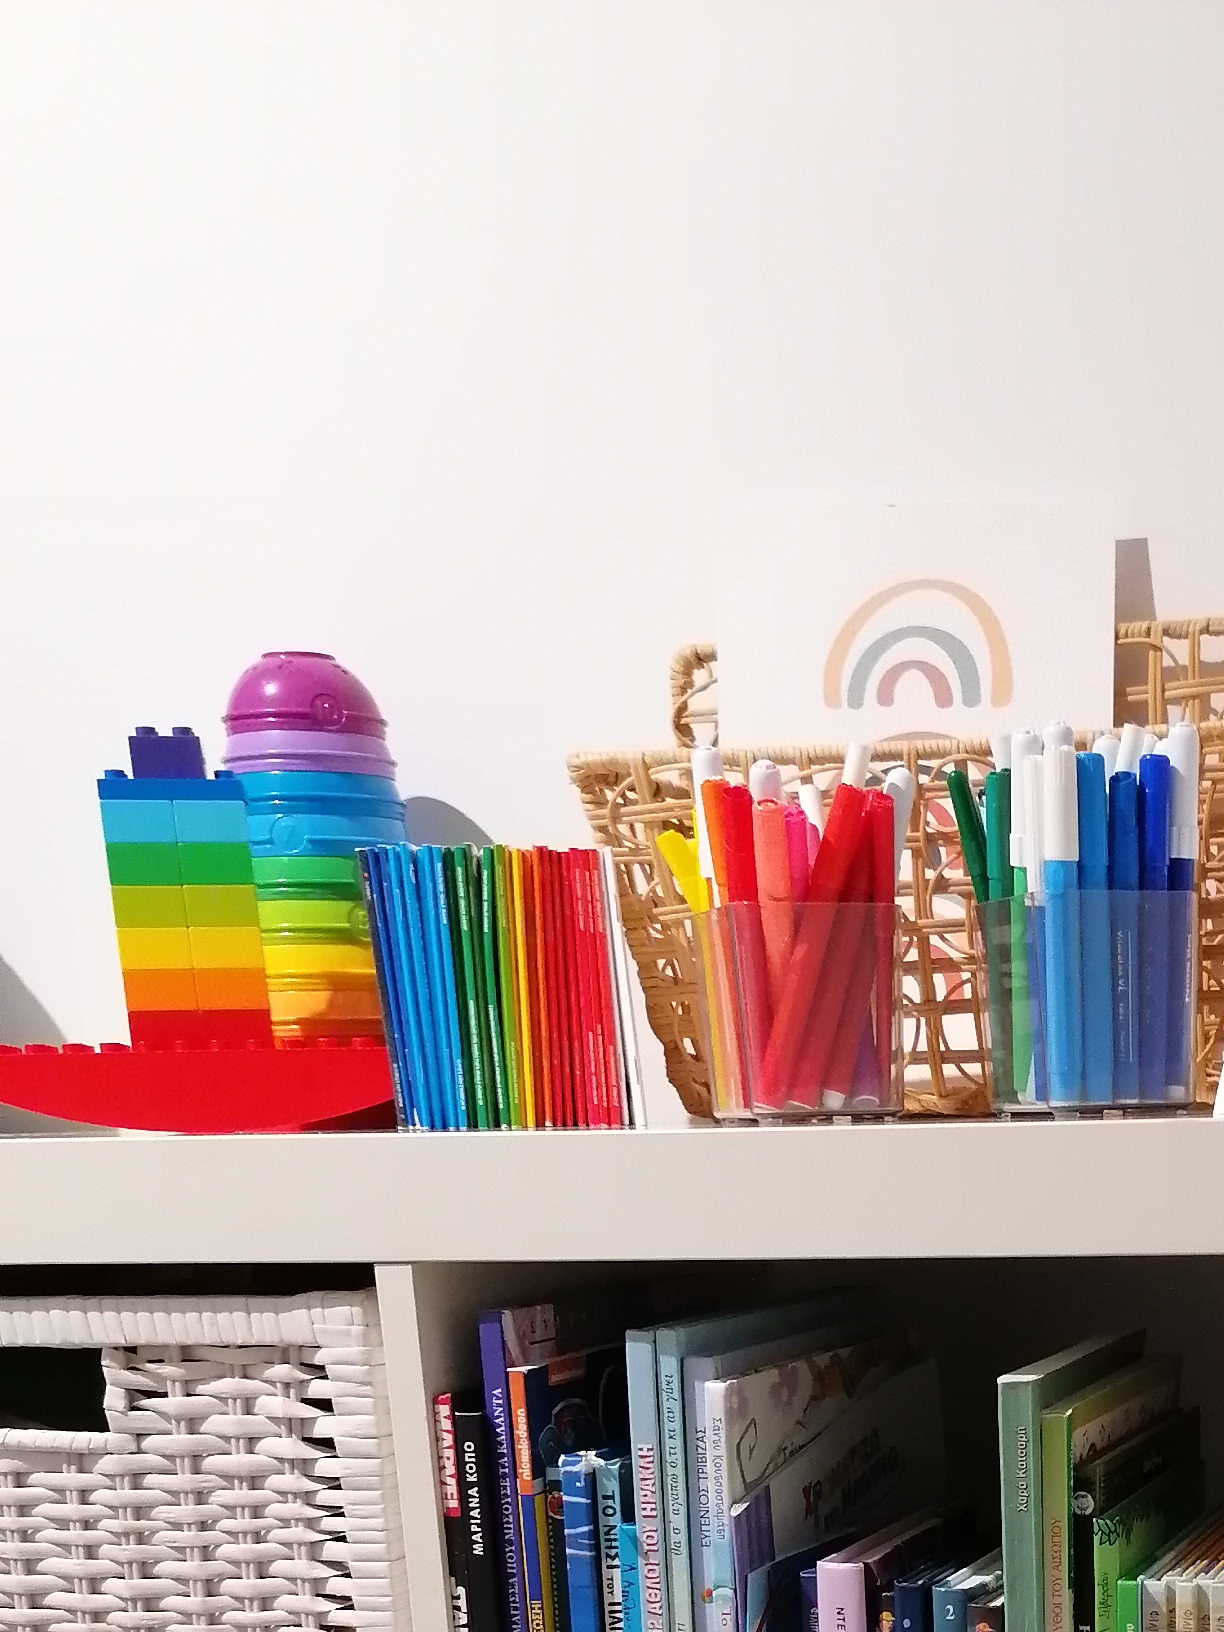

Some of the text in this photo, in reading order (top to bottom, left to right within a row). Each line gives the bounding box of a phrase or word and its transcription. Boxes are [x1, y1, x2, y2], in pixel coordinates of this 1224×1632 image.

[434, 1405, 459, 1509] MARVEL
[464, 1442, 477, 1482] ΚΟΠΟ
[602, 1491, 616, 1517] ΤΟ
[694, 1427, 711, 1548] ΕΥΓΕΝΙΟΣ ΤΡΙΒΙΖΑΣ
[468, 1487, 484, 1555] ΜΑΡΙΑΝΑ
[605, 1525, 619, 1570] ΝΗΣΙ
[1050, 1518, 1062, 1572] ΑΙΣΩΠΟΥ
[1051, 1575, 1062, 1599] ΤΟΥ
[945, 1605, 955, 1619] 2
